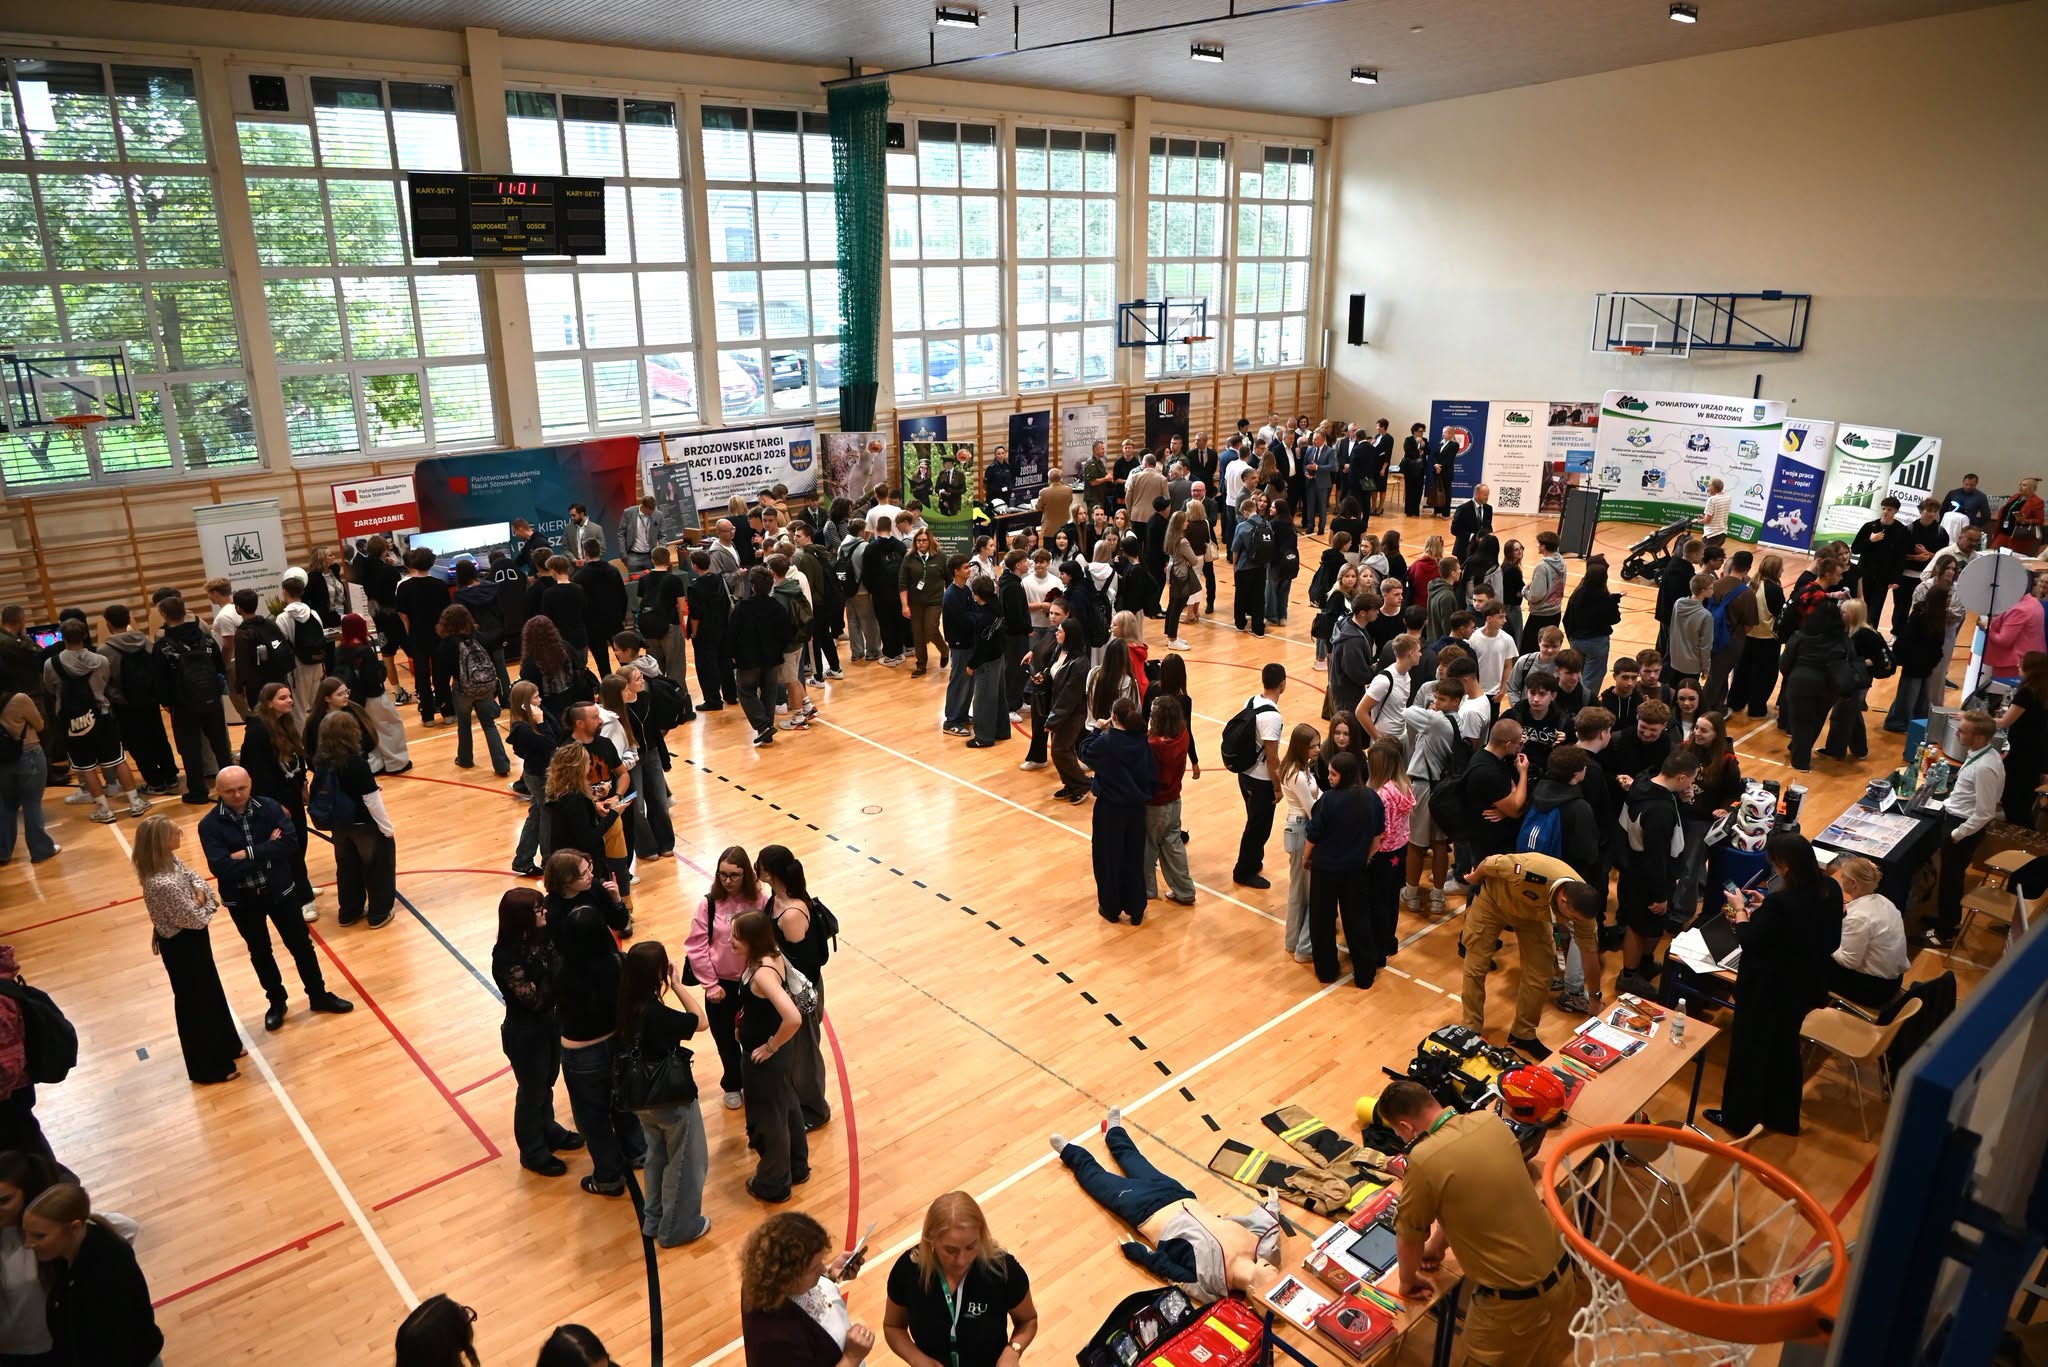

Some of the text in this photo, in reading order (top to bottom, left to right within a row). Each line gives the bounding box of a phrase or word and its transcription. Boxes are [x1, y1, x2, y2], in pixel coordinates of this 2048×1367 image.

[498, 182, 536, 195] 11:01
[501, 197, 513, 205] 3D
[1655, 401, 1744, 414] POWIATOWY URZĄD PRACY
[1706, 413, 1742, 422] BRZOZOWIE
[684, 436, 784, 456] BRZOZOWSKIE TARGI
[688, 449, 786, 469] RACY I EDUKACJI 2026
[471, 470, 540, 482] Państwowa Akademia
[700, 465, 763, 482] 15.09.2026
[765, 465, 772, 475] r.
[1782, 469, 1798, 477] Twoja
[490, 478, 532, 488] Stosowanych
[1890, 489, 1924, 503] ECOSARN
[354, 514, 404, 527] ZARZĄDZANIE
[538, 518, 572, 532] KIERU
[71, 709, 94, 731] NIKE
